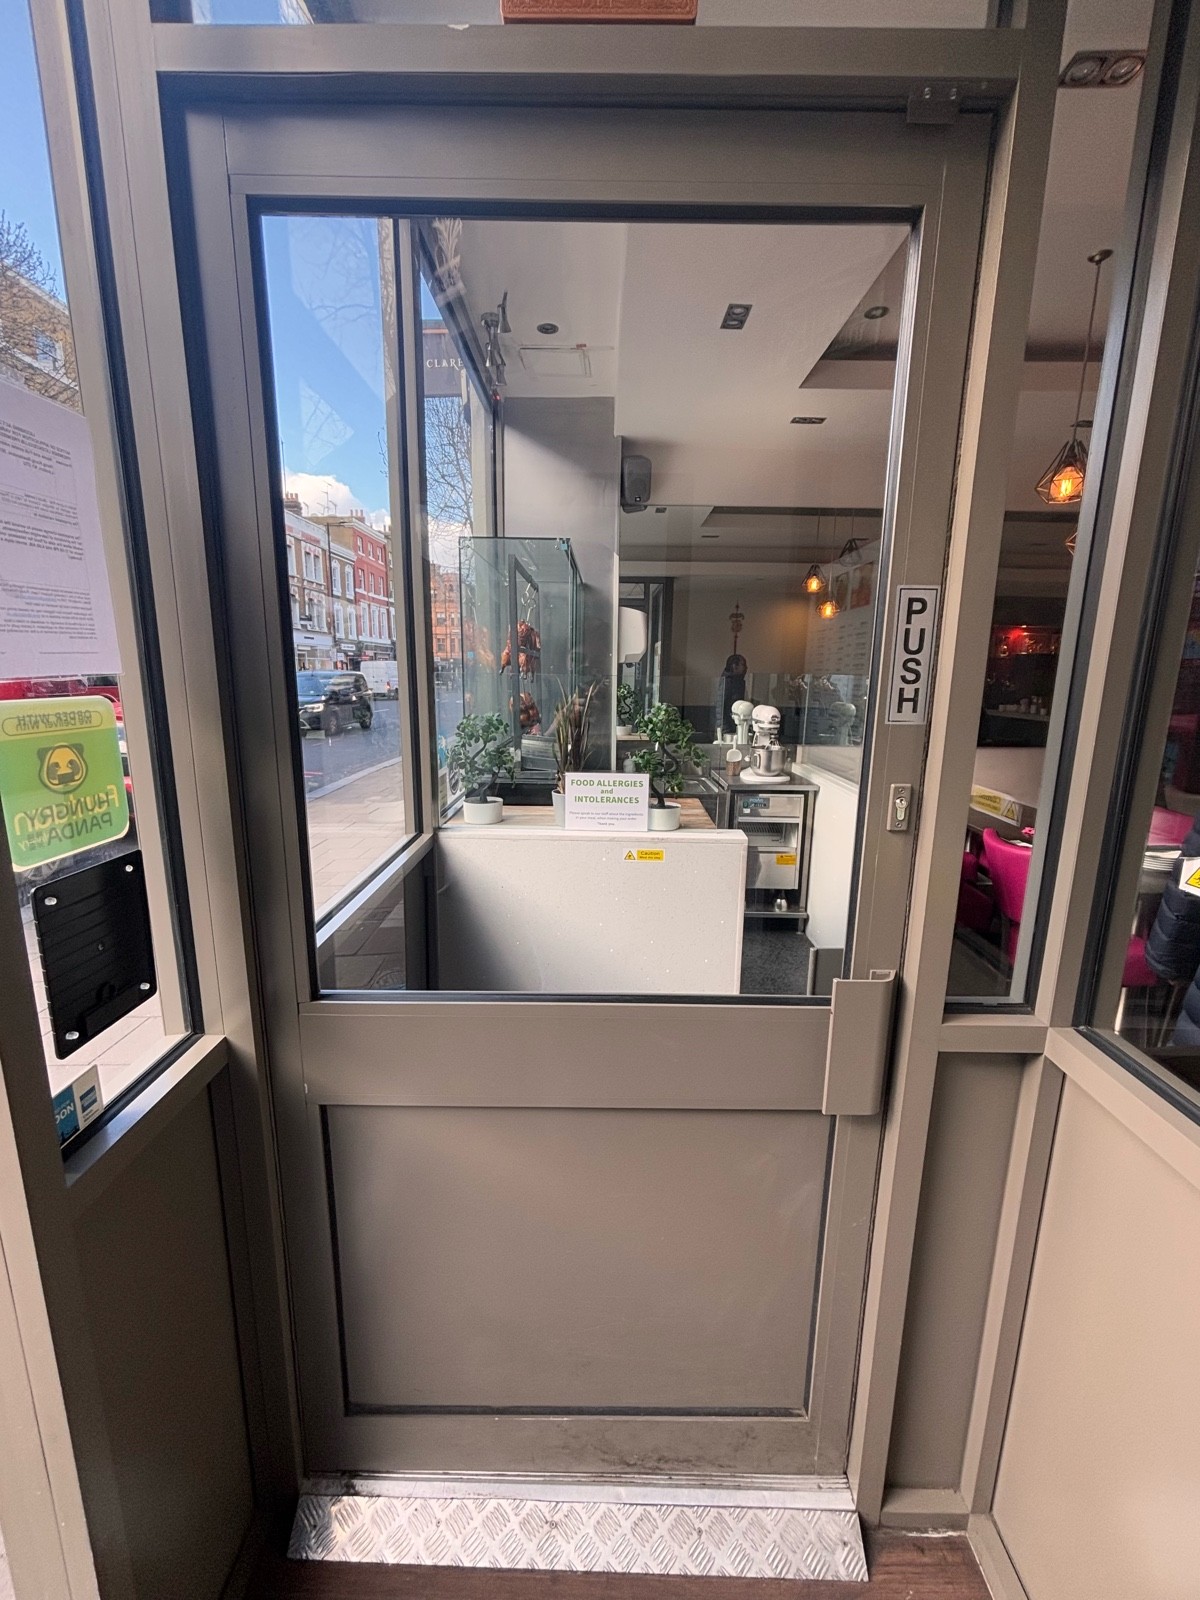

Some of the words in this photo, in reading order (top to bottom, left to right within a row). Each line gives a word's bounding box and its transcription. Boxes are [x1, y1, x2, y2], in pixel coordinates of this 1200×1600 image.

[897, 597, 928, 714] PUSH
[570, 779, 595, 787] FOOD
[596, 779, 644, 788] ALLERGIES
[574, 795, 640, 804] INTOLERANCES
